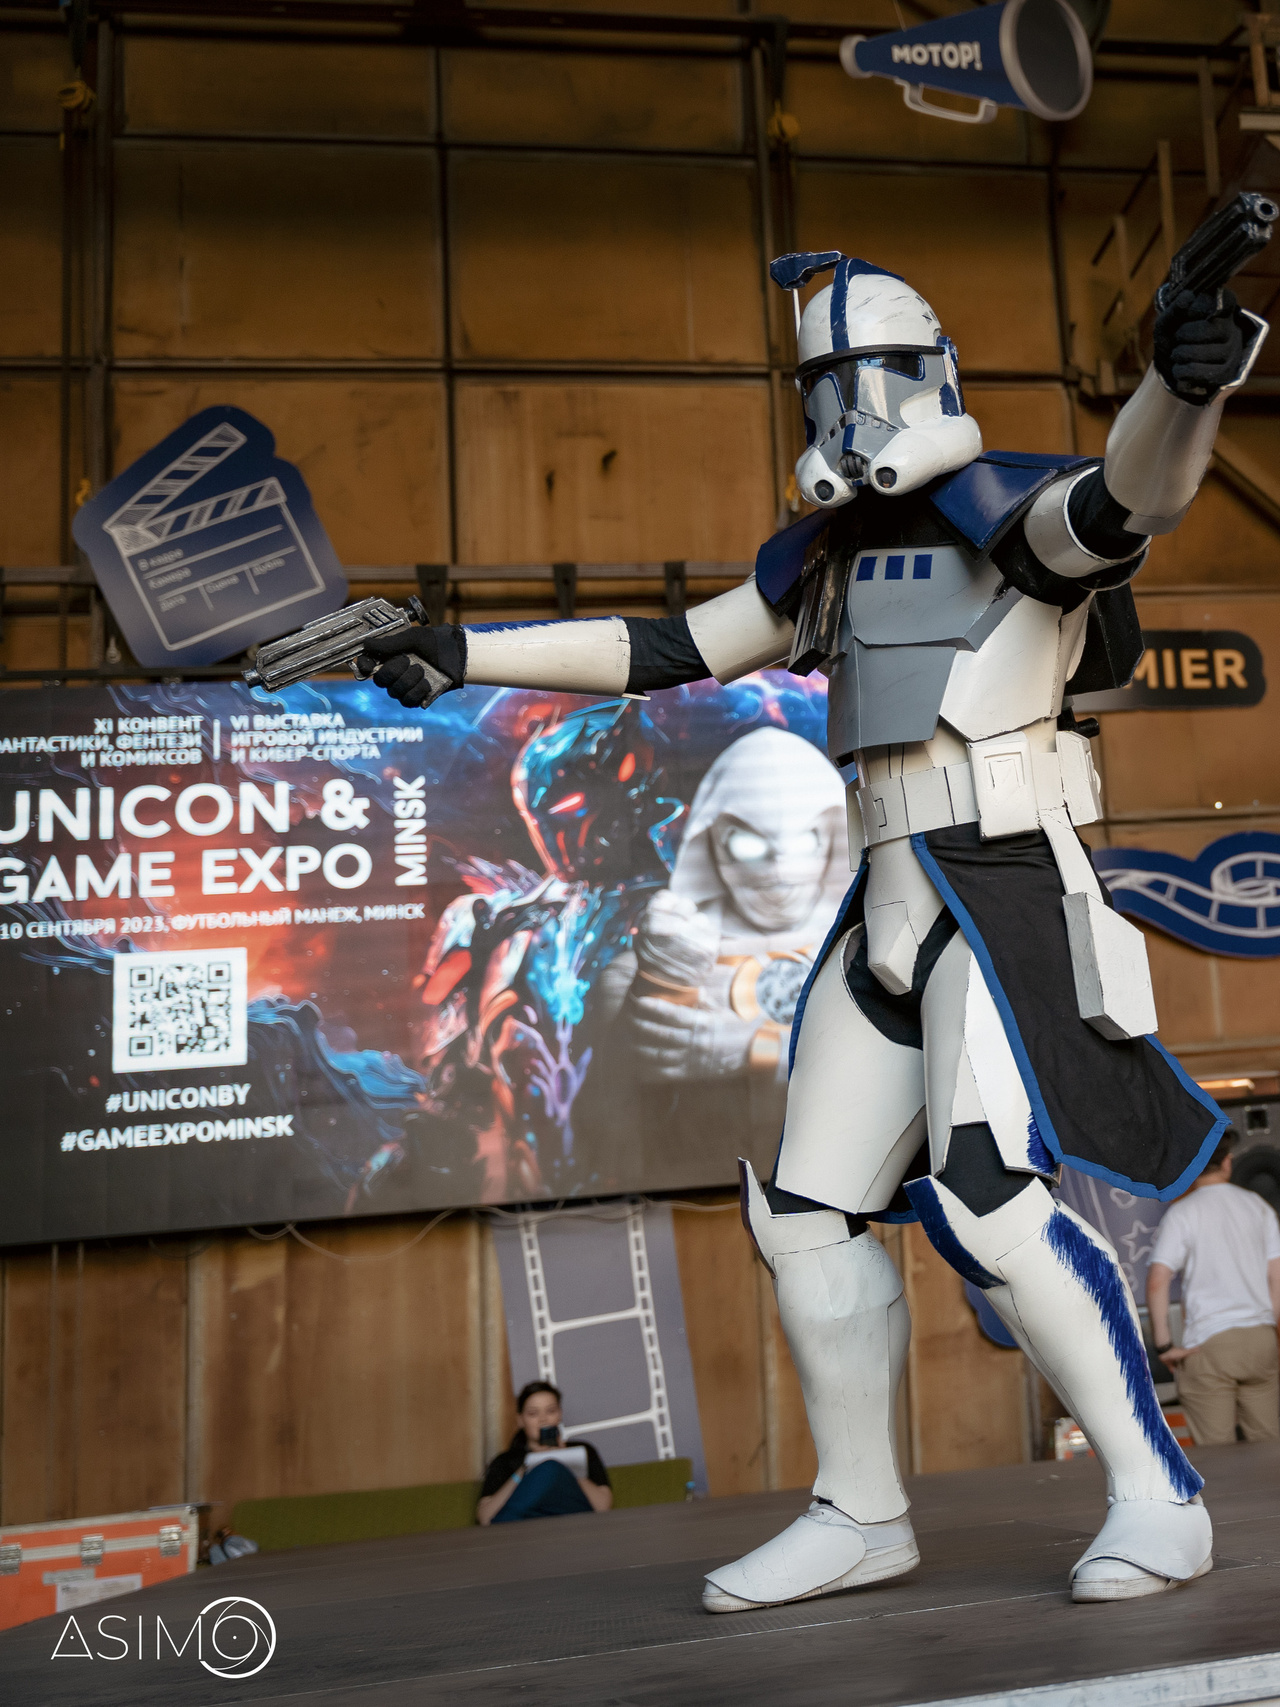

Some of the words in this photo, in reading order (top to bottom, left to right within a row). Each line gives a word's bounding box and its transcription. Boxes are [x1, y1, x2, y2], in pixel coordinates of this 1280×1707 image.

[891, 41, 983, 71] МОТОР!
[117, 715, 204, 734] КОНВЕНТ
[230, 727, 315, 747] ИГРОВОЙ
[317, 726, 424, 745] ИНДУСТРИИ
[253, 712, 346, 731] ВЫСТАВКА
[0, 734, 114, 754] АНТАСТИКИ,
[116, 732, 202, 751] ФЕНТЕЗИ
[80, 750, 96, 768] И
[99, 747, 202, 767] КОМИКСОВ
[230, 746, 246, 764] И
[249, 743, 382, 763] КИБЕР-СПОРТА
[0, 780, 291, 845] UNICON
[320, 778, 371, 832] &
[394, 775, 428, 887] MINSK
[0, 850, 176, 905] GAME
[201, 843, 373, 895] EXPO
[0, 922, 23, 940] 10
[25, 918, 116, 938] СЕНТЯБРЯ
[120, 915, 170, 934] 2023,
[170, 907, 292, 931] ФУТБОЛЬНЫЙ
[363, 903, 426, 921] МИНСК
[105, 1083, 251, 1114] #UNICONBY
[60, 1115, 294, 1152] #GAMEEXPOMINSK
